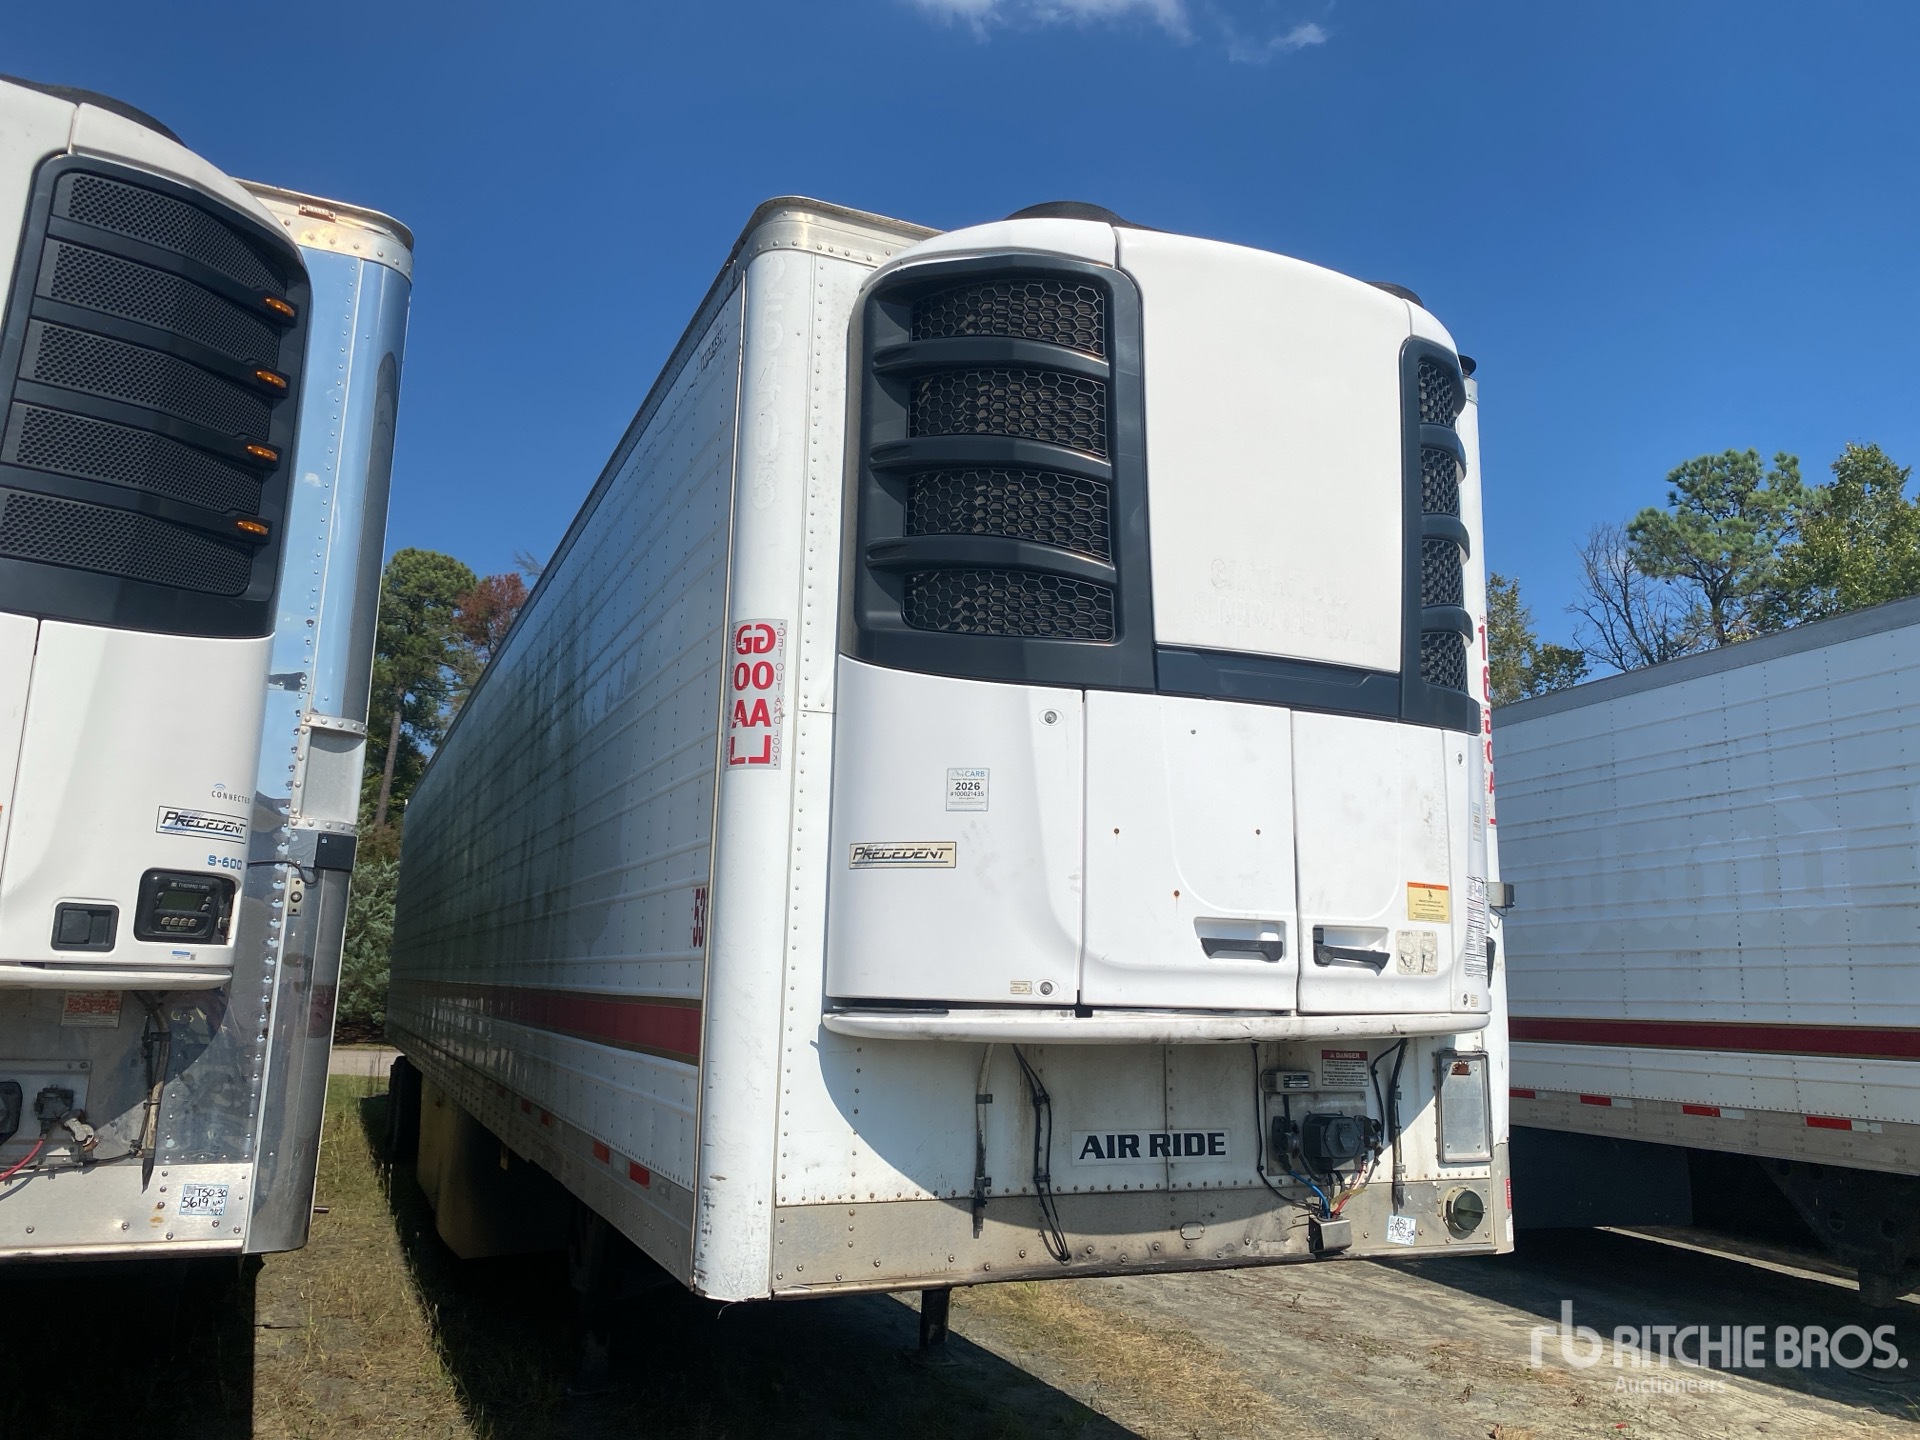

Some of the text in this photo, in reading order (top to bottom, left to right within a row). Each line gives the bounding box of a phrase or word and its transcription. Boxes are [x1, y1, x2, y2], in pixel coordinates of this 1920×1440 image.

[964, 770, 986, 778] CARB
[955, 781, 981, 791] 2026
[211, 790, 250, 804] CONNECTED
[162, 811, 247, 835] PRECEDENT
[853, 847, 953, 860] PRECEDENT
[207, 854, 243, 870] S-600
[1079, 1132, 1227, 1160] AIR RIDE
